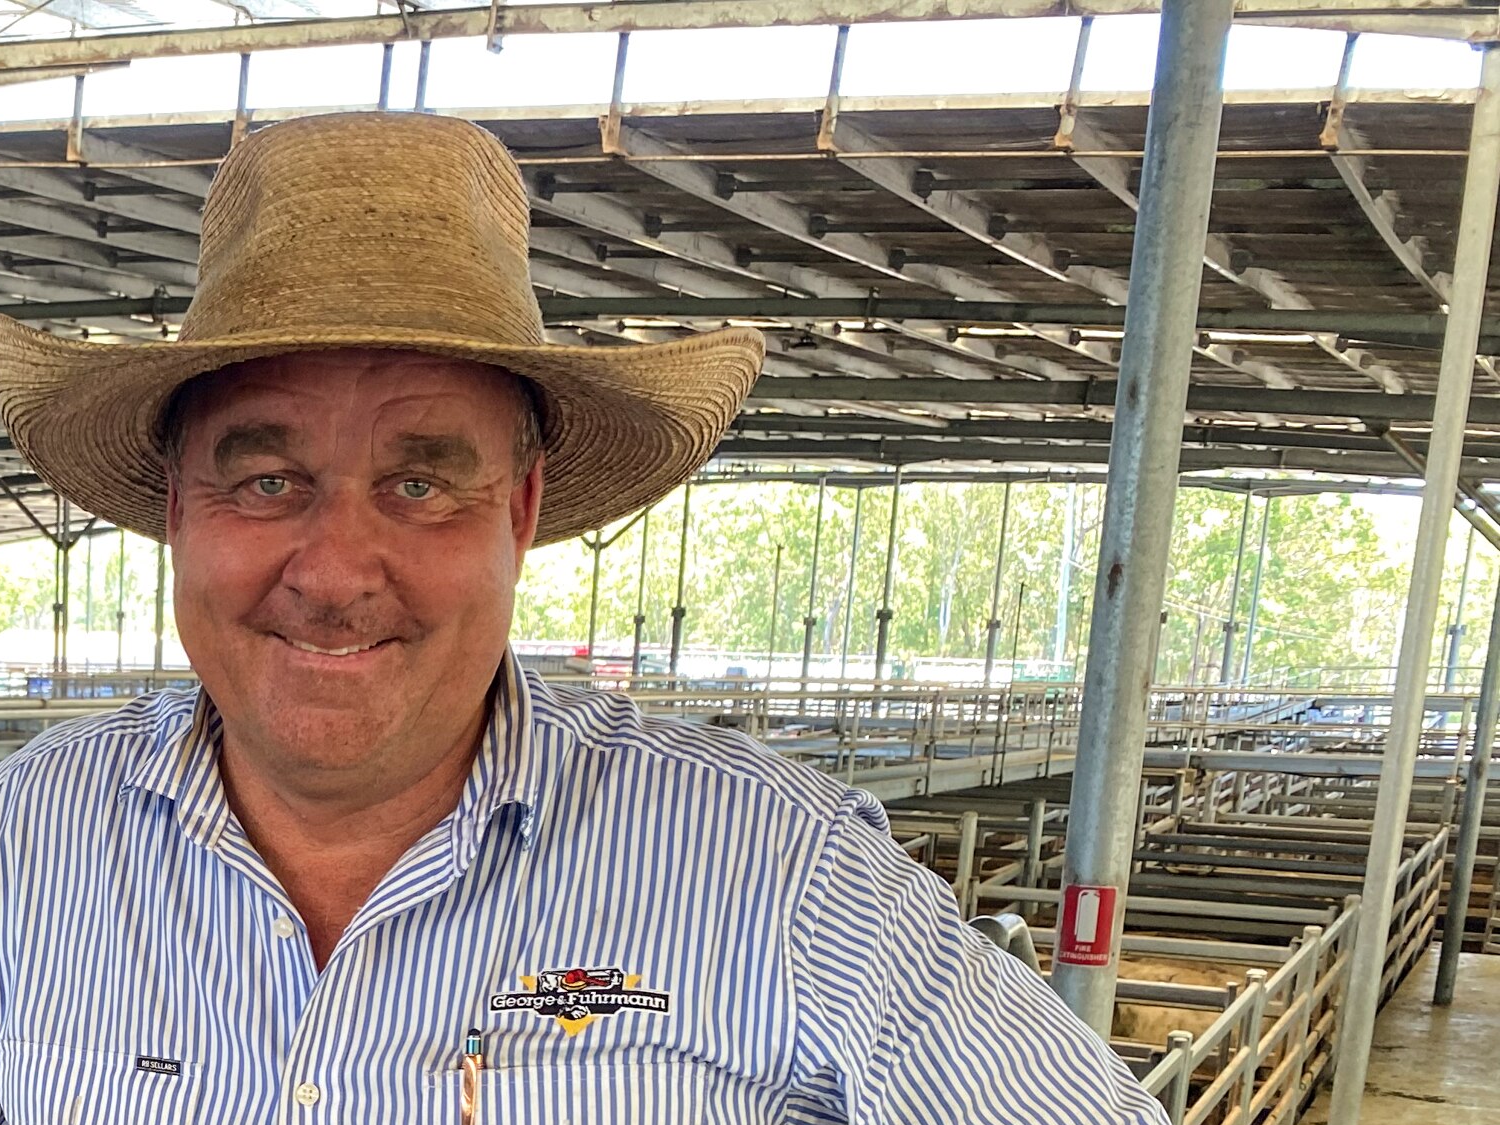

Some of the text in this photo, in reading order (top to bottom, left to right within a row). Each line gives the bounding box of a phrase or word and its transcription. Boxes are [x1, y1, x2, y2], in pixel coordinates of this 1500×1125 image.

[1074, 944, 1092, 953] FIRE
[492, 991, 666, 1009] George & Fuhrmann
[150, 1061, 177, 1072] SELLARS
